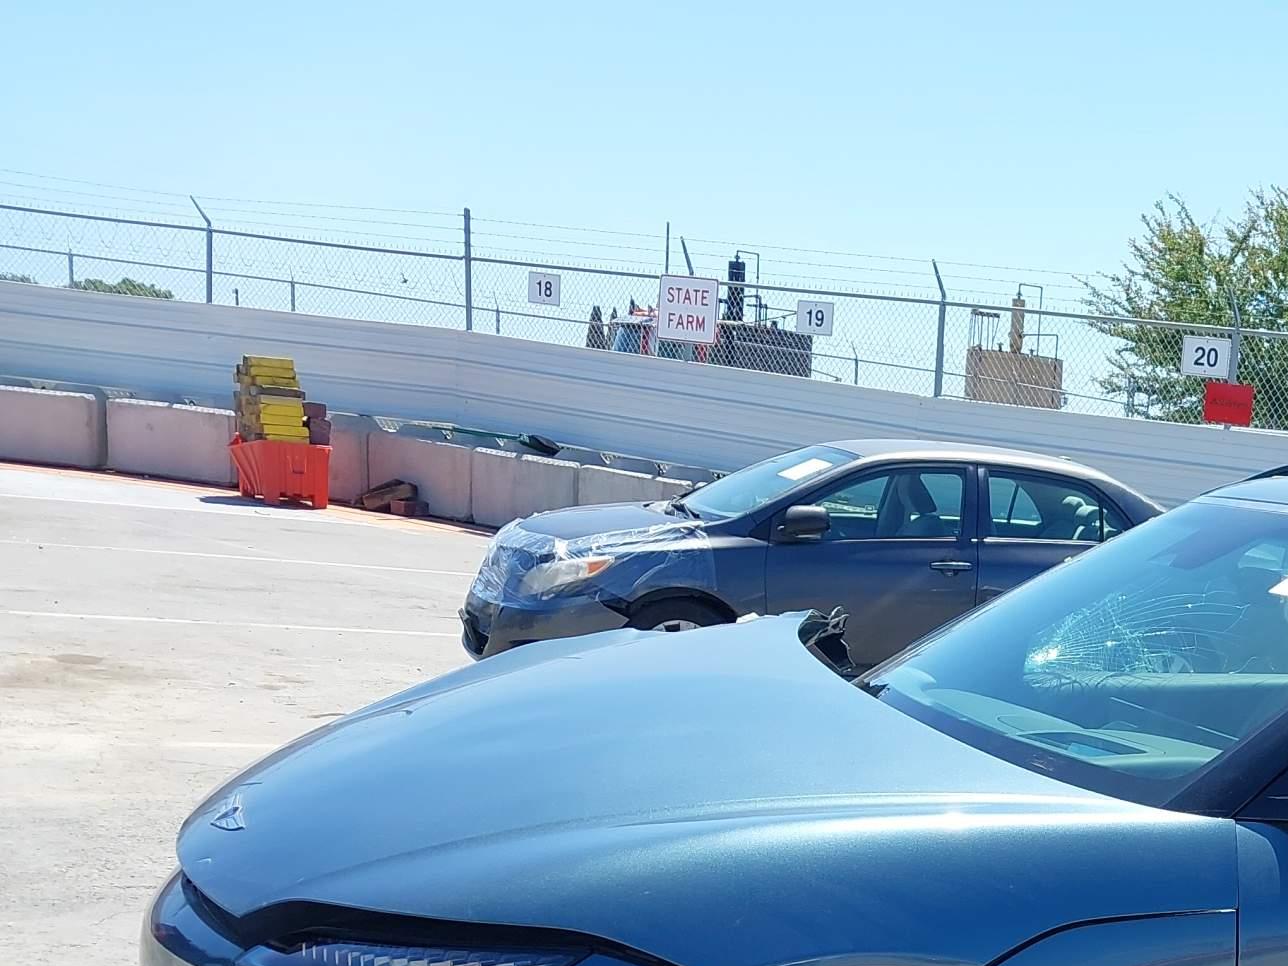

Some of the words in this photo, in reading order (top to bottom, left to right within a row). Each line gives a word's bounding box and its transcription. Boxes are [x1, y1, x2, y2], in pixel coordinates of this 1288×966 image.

[536, 280, 553, 297] 18
[666, 287, 710, 306] STATE
[667, 312, 706, 332] FARM
[805, 309, 824, 328] 19
[1193, 346, 1219, 367] 20
